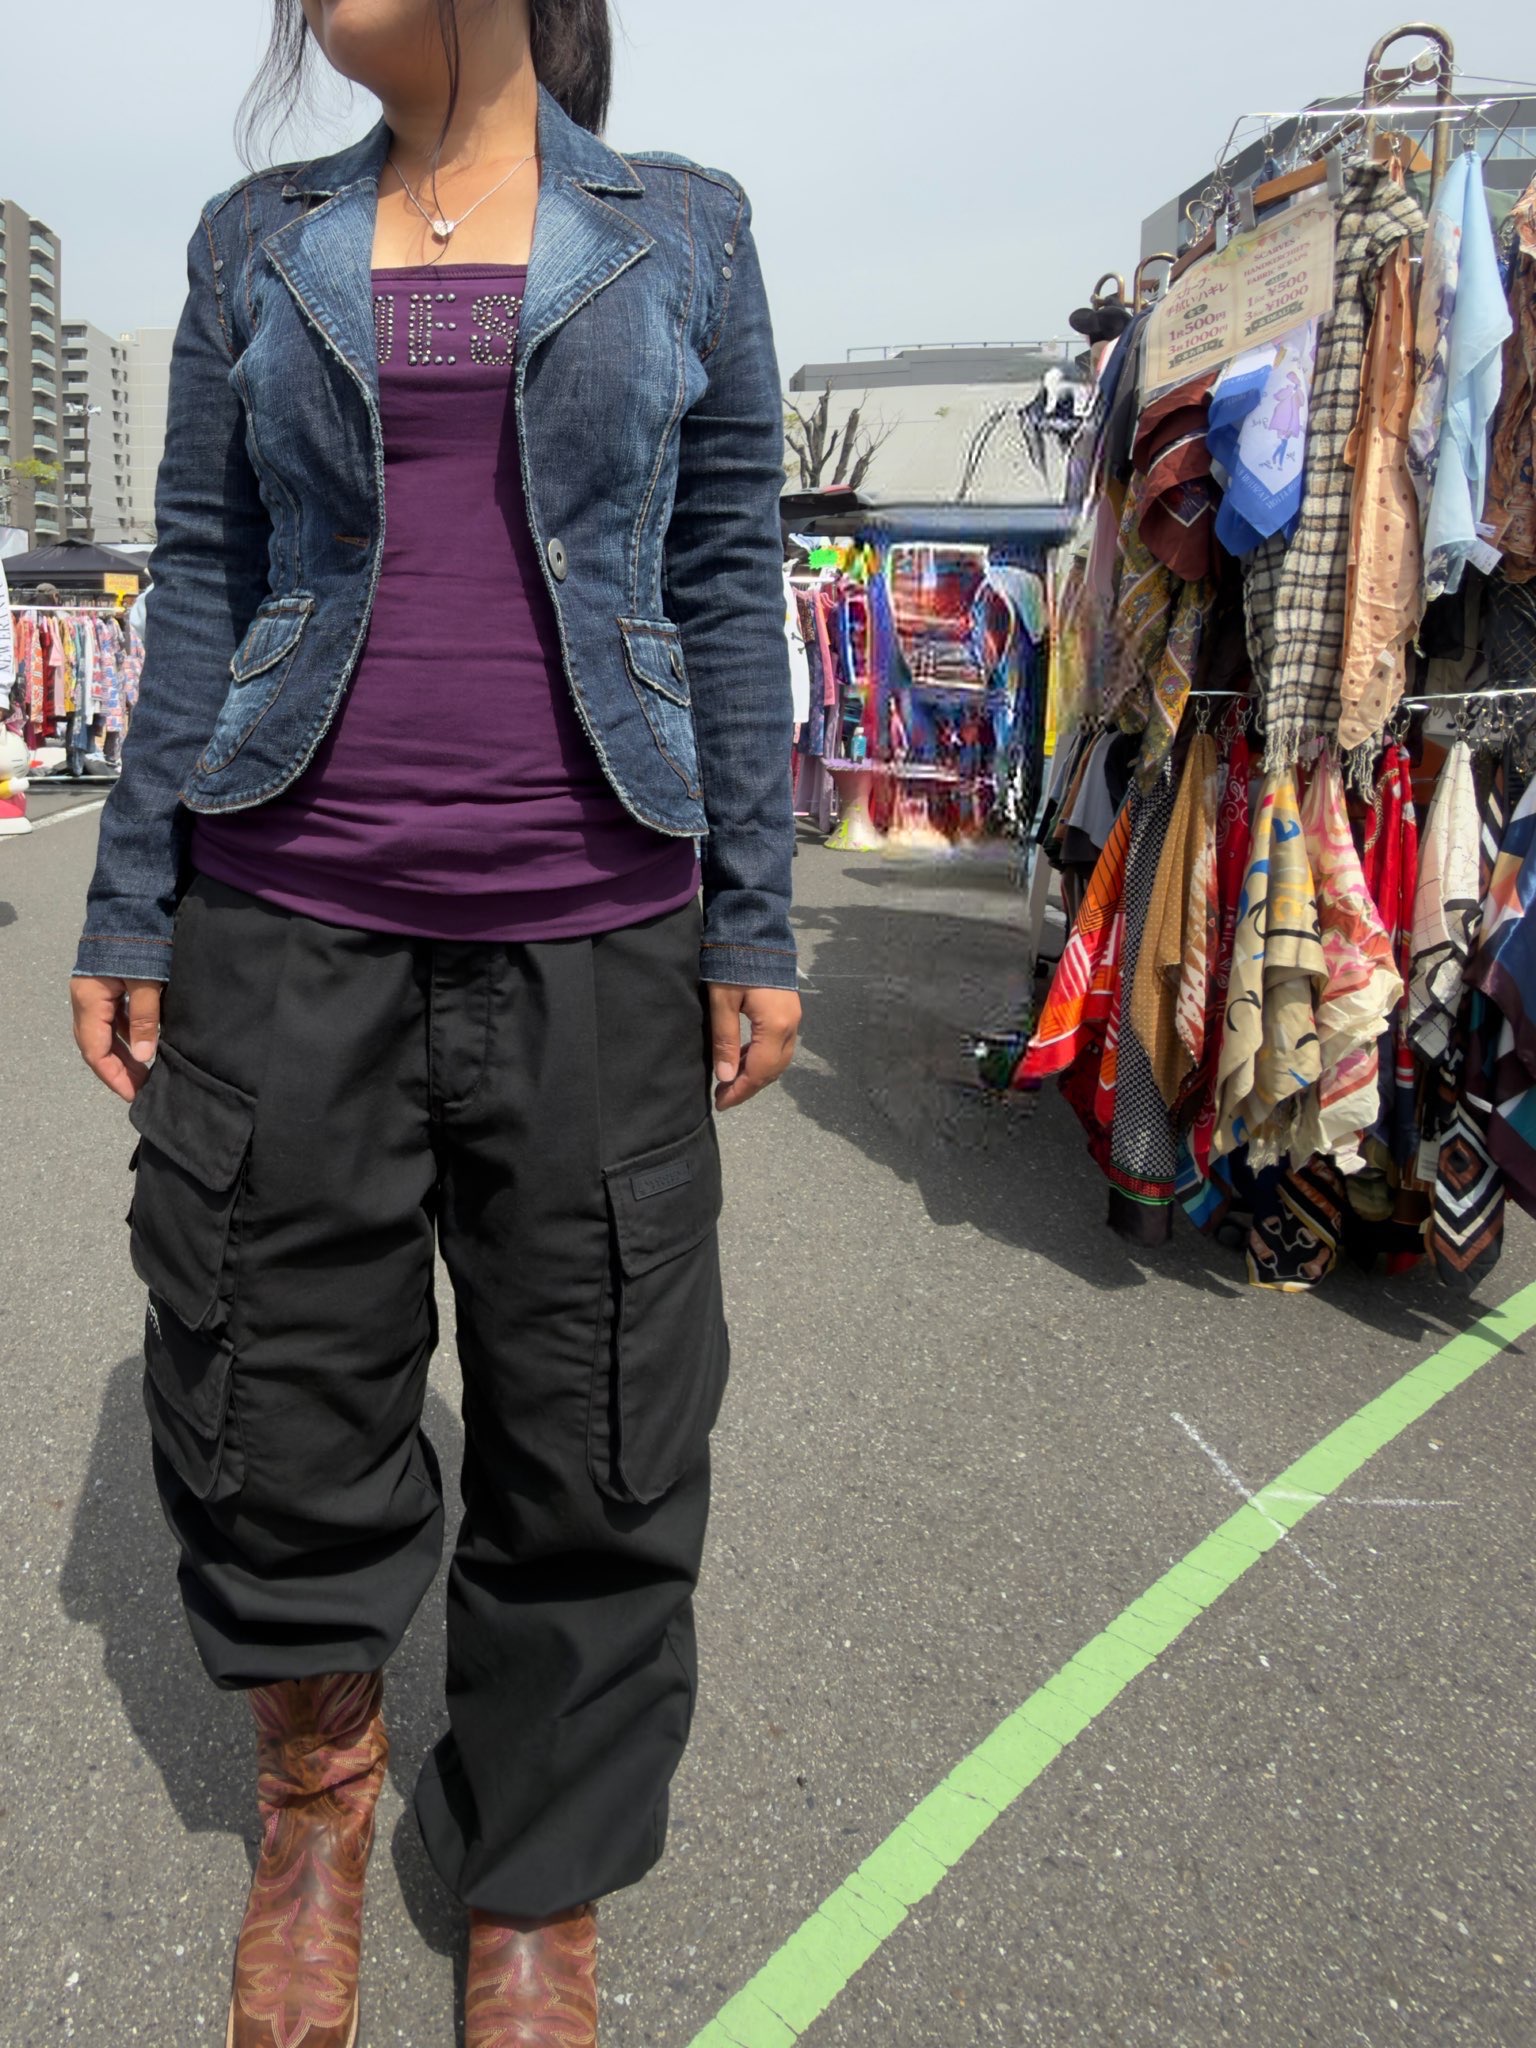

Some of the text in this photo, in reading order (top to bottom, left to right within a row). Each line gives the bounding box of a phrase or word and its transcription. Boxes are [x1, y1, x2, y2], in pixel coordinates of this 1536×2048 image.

[1254, 239, 1295, 261] SCARVES
[1268, 271, 1307, 297] ¥500
[1265, 284, 1309, 311] ¥1000
